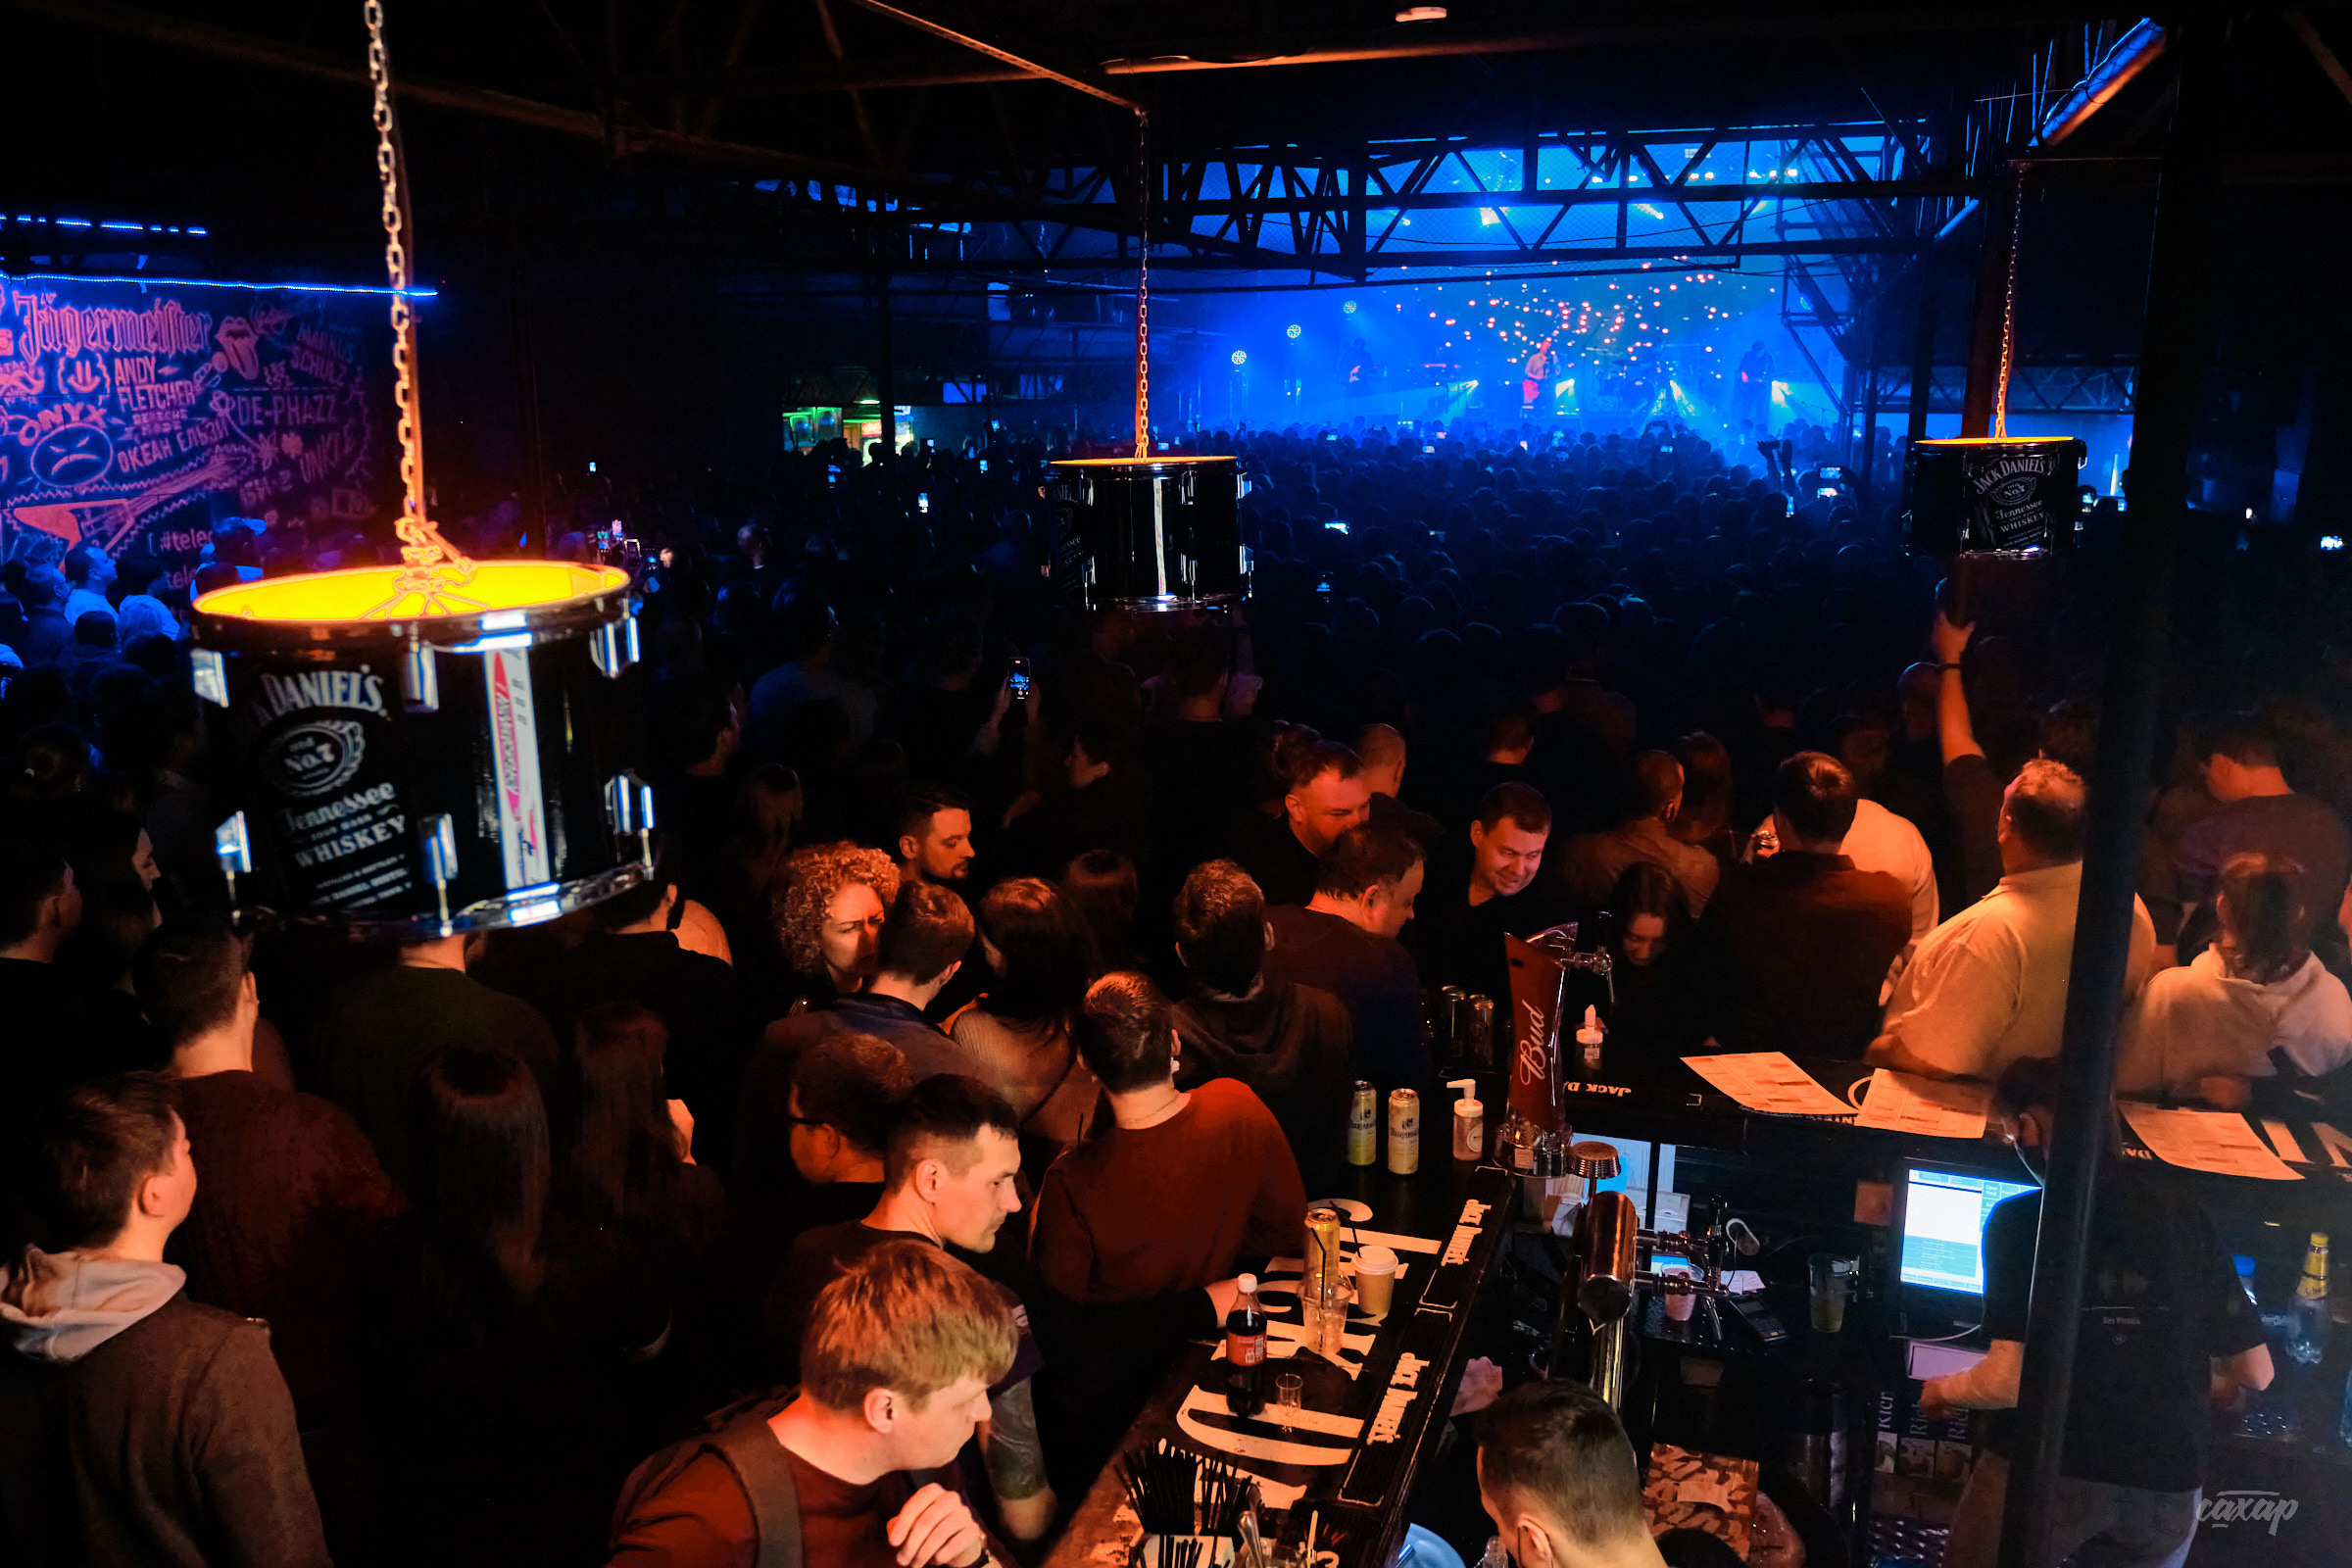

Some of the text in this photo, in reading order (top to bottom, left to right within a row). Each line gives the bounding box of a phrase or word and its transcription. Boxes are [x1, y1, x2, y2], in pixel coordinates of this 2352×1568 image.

[115, 356, 157, 386] ANDY
[117, 379, 196, 412] FLETCHER
[236, 394, 338, 425] DE-PHAZZ
[19, 402, 107, 446] ONYX
[118, 416, 229, 473] ОКЕАН ЕЛЬЗИ
[1973, 466, 2002, 495] JACK
[1999, 457, 2046, 476] DANIEL'S
[1995, 500, 2043, 520] Tennessee
[2000, 511, 2044, 533] WHISKEY
[280, 782, 397, 833] Tennessee
[294, 814, 406, 868] WHISKEY
[1519, 999, 1546, 1085] Bud
[1586, 1082, 1632, 1097] JACK
[1390, 1352, 1431, 1389] JACK
